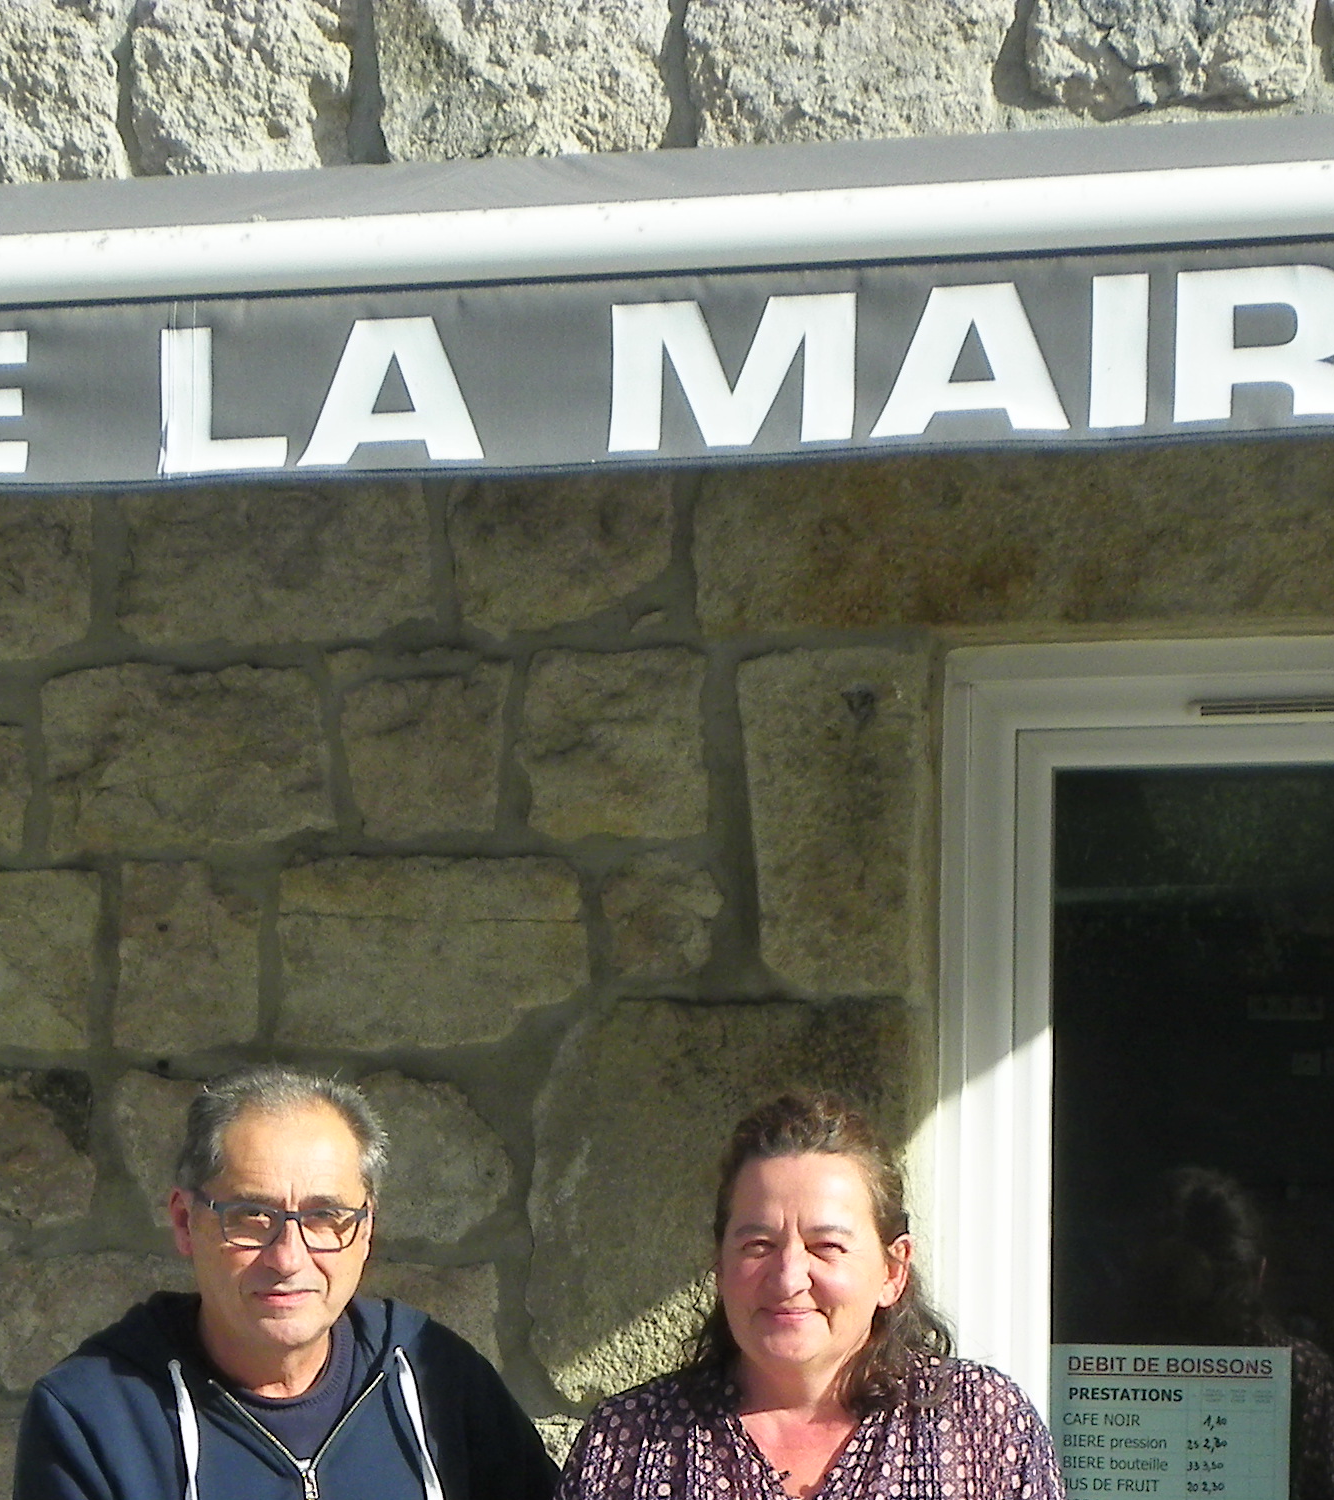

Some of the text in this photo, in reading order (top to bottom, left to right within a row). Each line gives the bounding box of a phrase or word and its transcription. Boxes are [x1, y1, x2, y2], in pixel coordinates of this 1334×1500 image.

[157, 317, 485, 476] LA
[1068, 1356, 1273, 1375] DEBIT DE BOISSONS
[1069, 1387, 1183, 1402] PRESTATIONS
[1063, 1412, 1141, 1426] CAFE NOIR
[1063, 1434, 1167, 1451] BIERE pression
[1063, 1456, 1168, 1471] BIERE bouteille
[1093, 1478, 1112, 1491] DE
[1117, 1479, 1160, 1492] FRUIT
